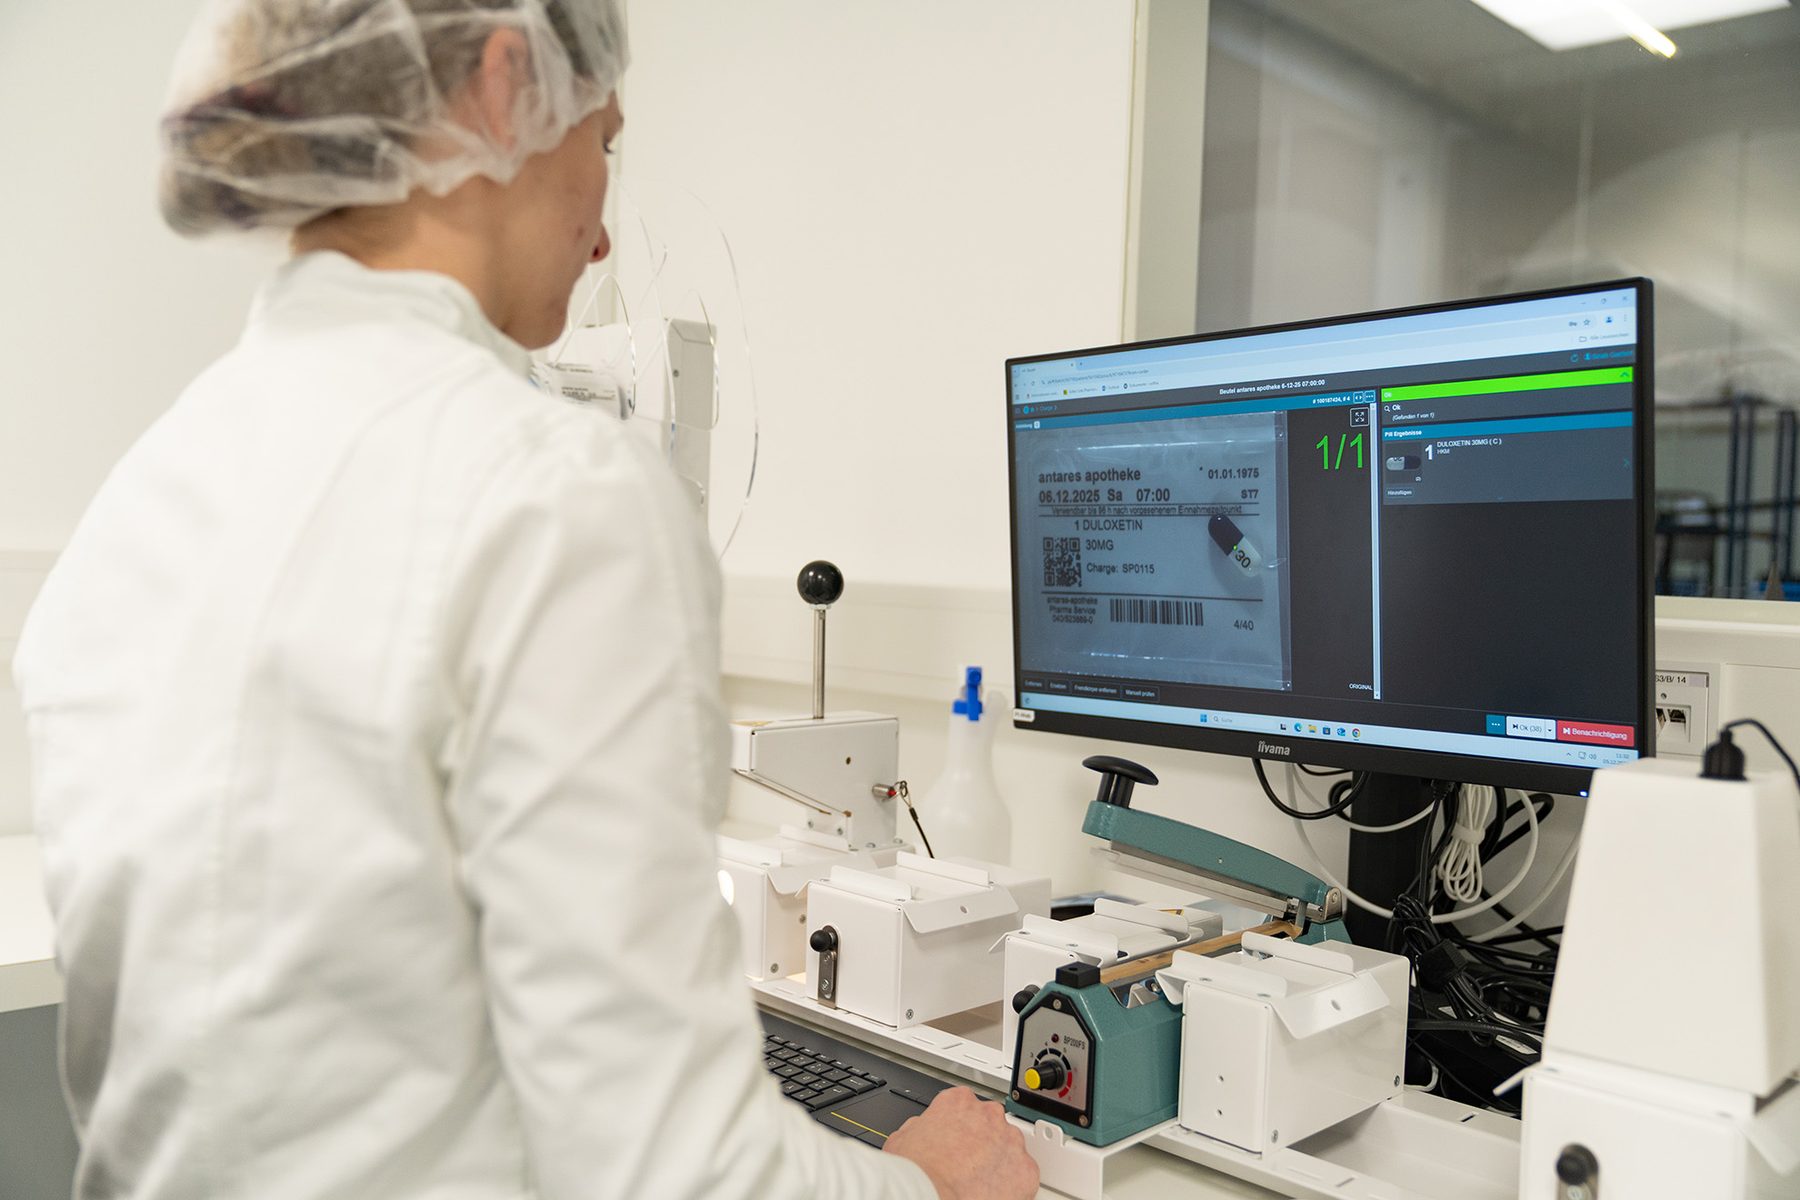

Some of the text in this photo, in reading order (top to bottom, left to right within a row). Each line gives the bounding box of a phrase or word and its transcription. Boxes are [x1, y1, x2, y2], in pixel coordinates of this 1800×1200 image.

[1219, 387, 1236, 395] Beutel
[1236, 385, 1256, 394] antares
[1256, 383, 1281, 393] apotheke
[1302, 379, 1326, 388] 07:00:00
[1393, 430, 1422, 438] Ergebnisse
[1316, 432, 1364, 470] 1/1
[1425, 444, 1433, 461] 1
[1436, 440, 1471, 448] DULOXETIN
[1038, 467, 1141, 485] antares apotheke
[1208, 467, 1260, 480] 01.01.1975
[1038, 488, 1170, 503] 06.12.2025 Sa 07:00
[1241, 489, 1259, 499] ST7
[1074, 519, 1143, 531] 1 DULOXETIN
[1086, 539, 1114, 551] 30MG
[1235, 550, 1251, 569] 30
[1086, 562, 1155, 575] Charge: SP0115
[1233, 620, 1254, 631] 4/40
[1349, 683, 1373, 691] ORIGINAL
[1520, 724, 1529, 732] Ok
[1571, 728, 1628, 741] Benachrichtigung
[1257, 740, 1291, 756] iiyama
